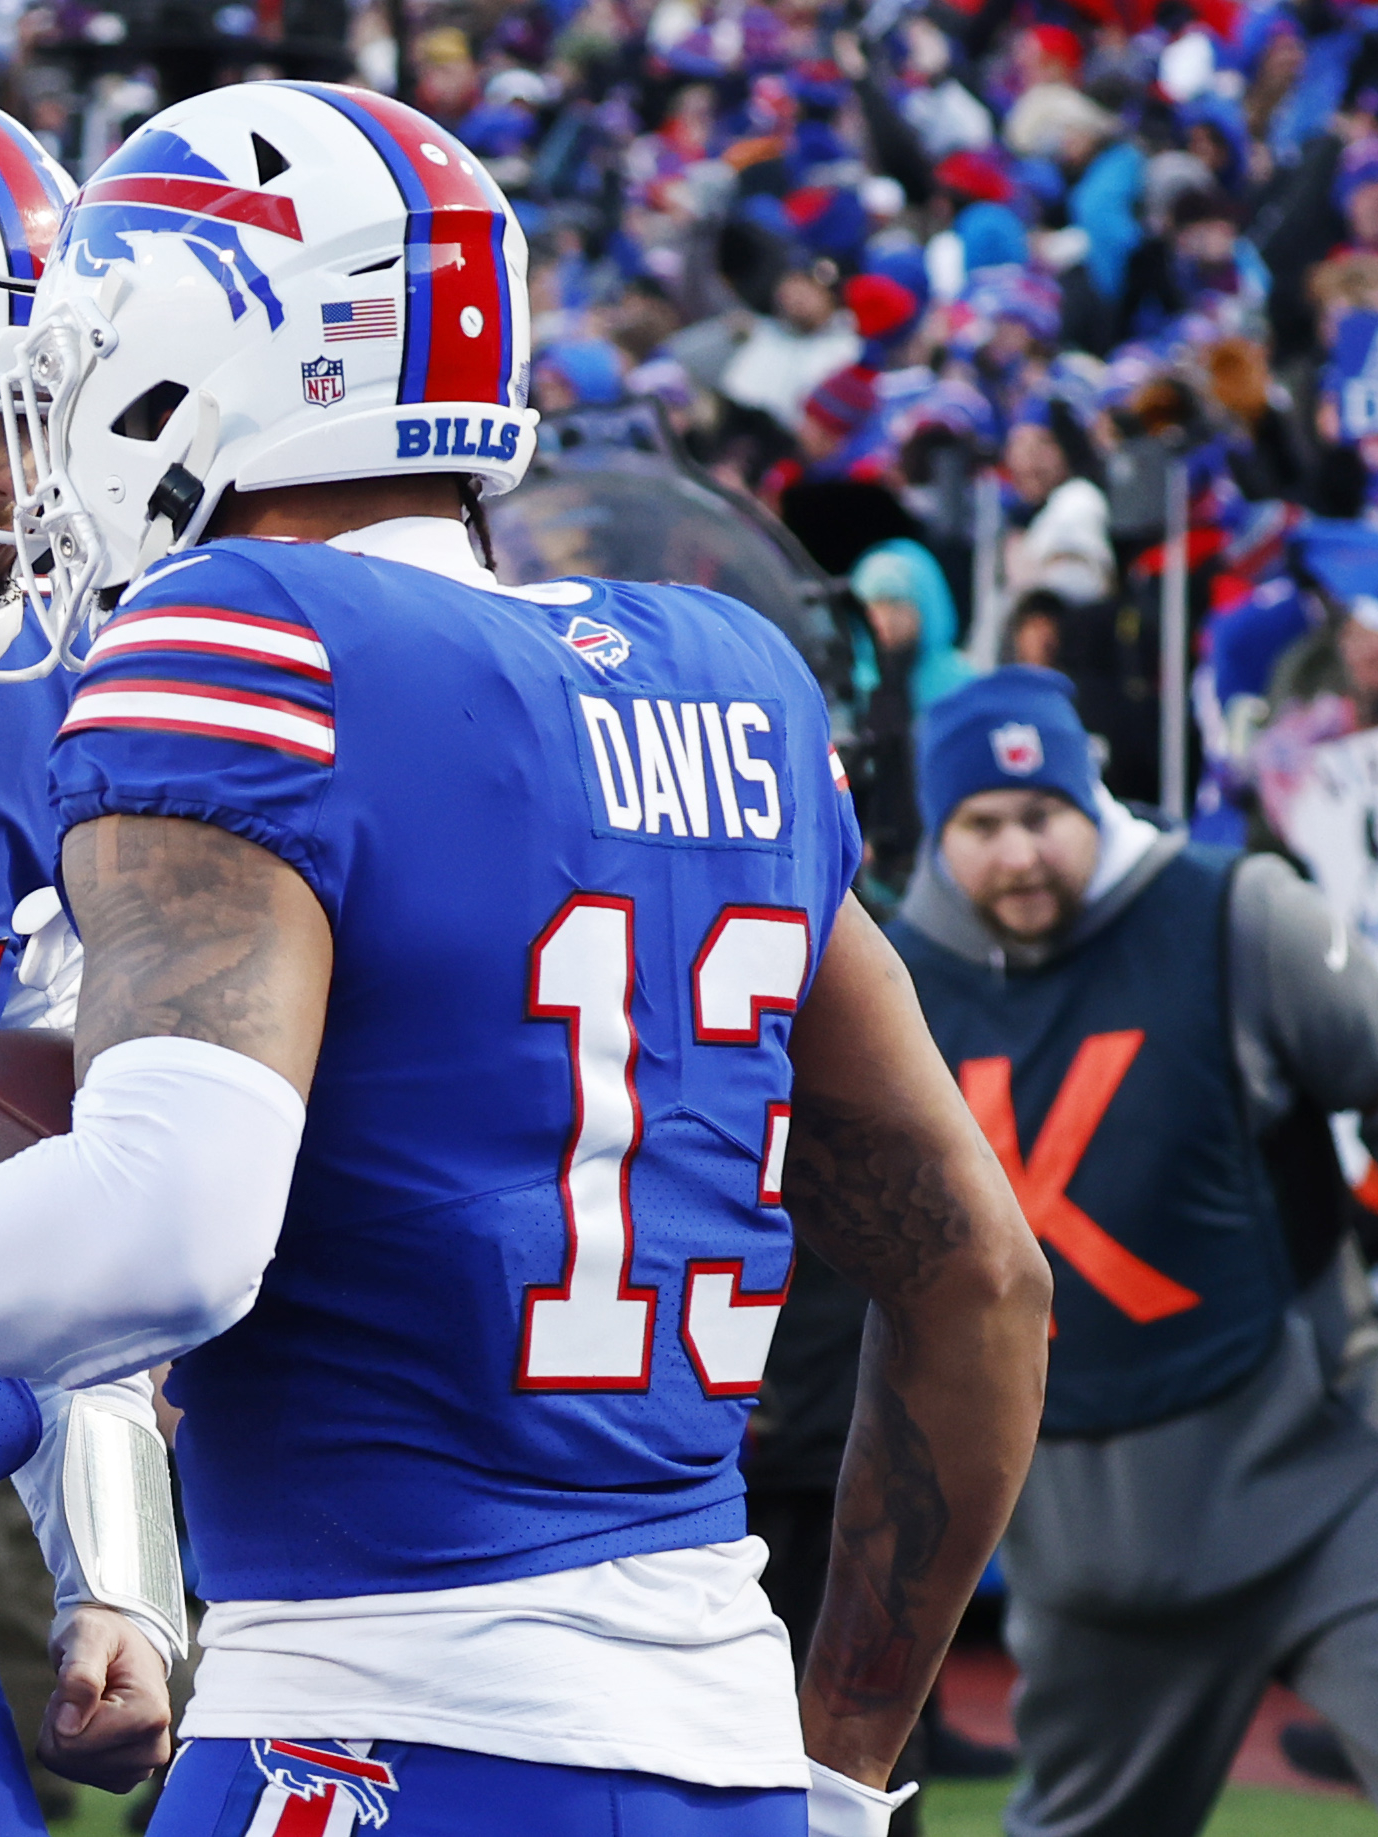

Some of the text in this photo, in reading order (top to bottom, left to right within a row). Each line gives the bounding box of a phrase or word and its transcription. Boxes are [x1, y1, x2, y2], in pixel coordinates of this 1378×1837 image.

[306, 377, 342, 403] NFL
[396, 417, 521, 461] BILLS
[578, 693, 782, 840] DAVIS
[512, 888, 811, 1401] 13
[958, 1028, 1202, 1340] K
